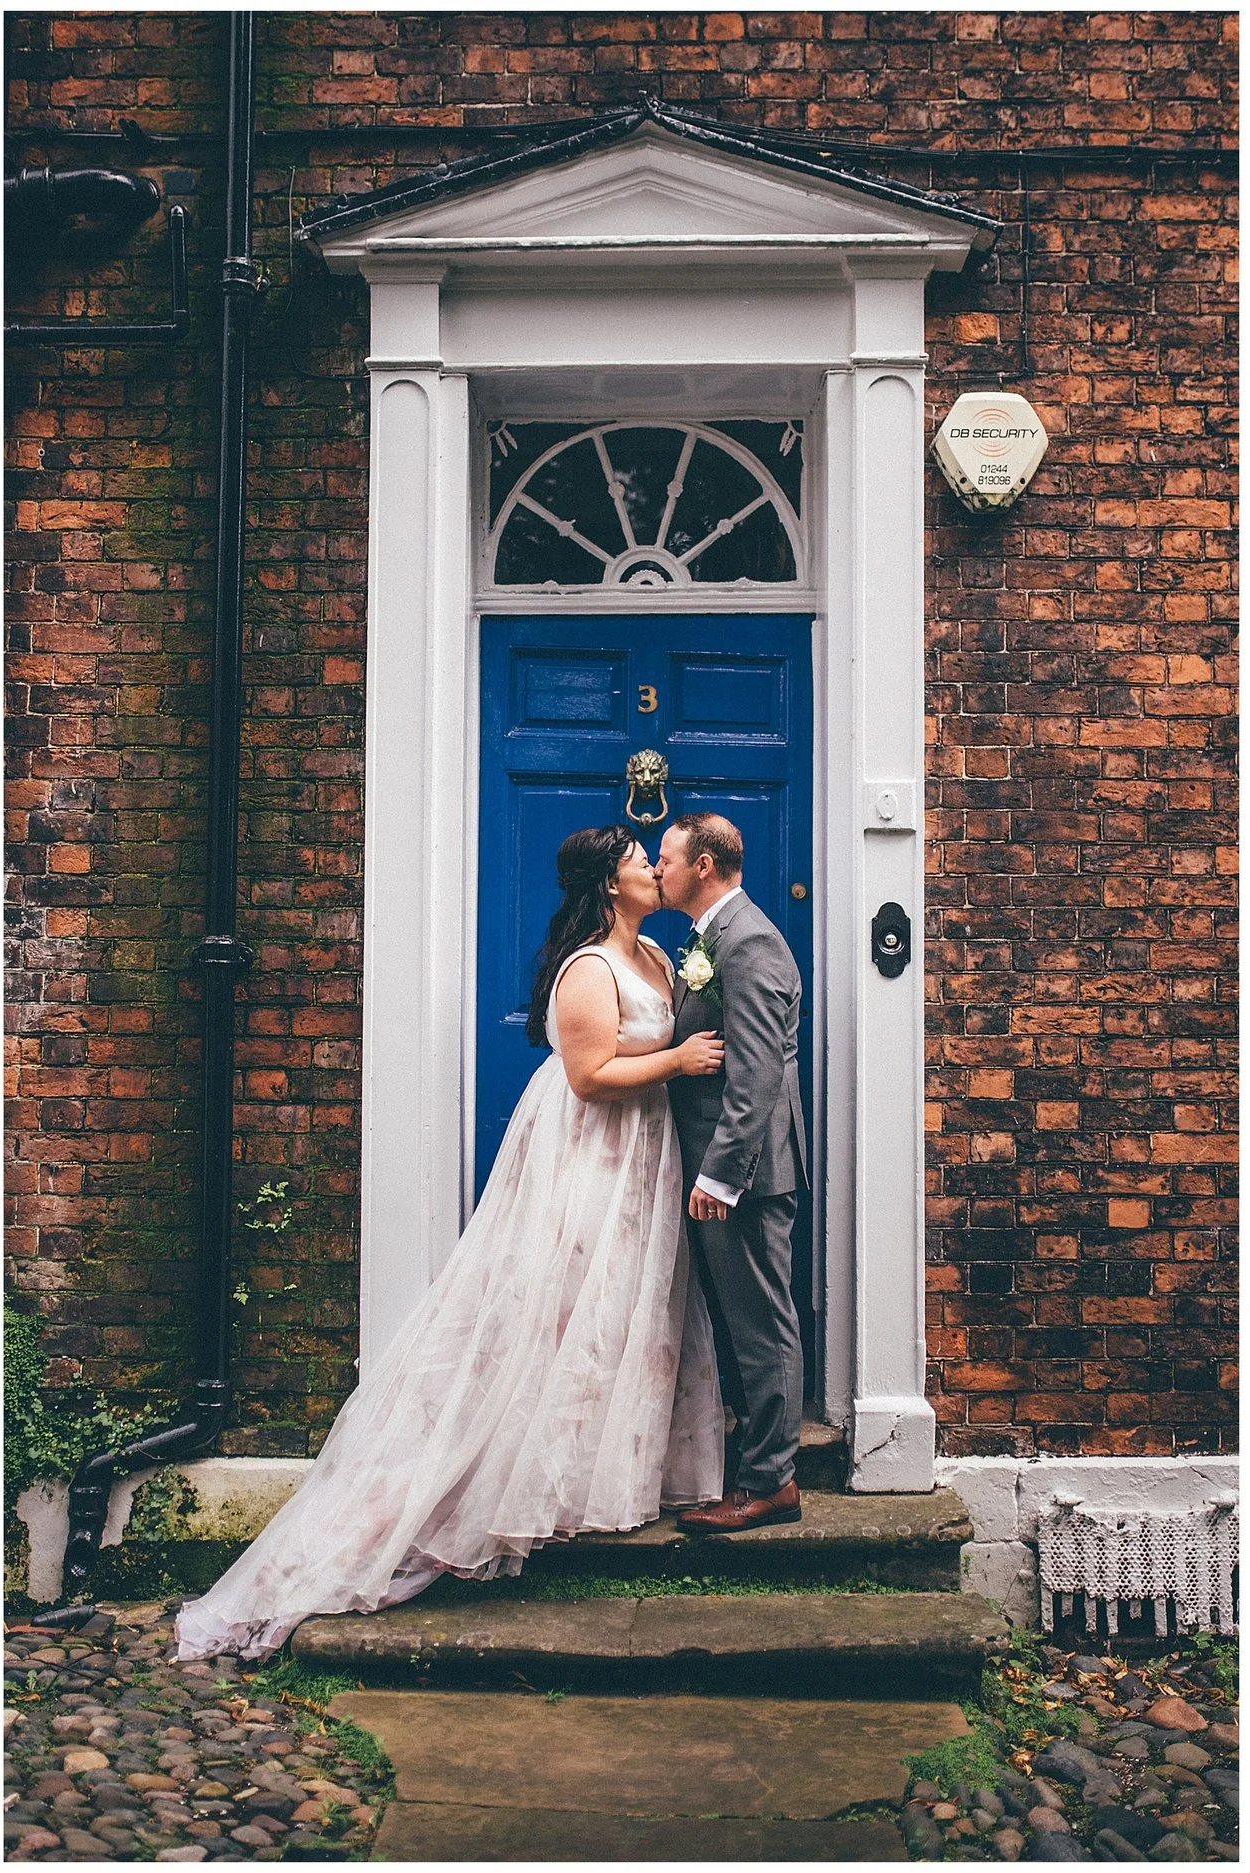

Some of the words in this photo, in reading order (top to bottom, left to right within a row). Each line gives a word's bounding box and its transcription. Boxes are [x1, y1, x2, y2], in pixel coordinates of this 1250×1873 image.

[950, 428, 970, 438] DB
[972, 428, 1039, 439] SECURITY
[980, 464, 1008, 473] 01244
[978, 475, 1011, 485] 819096
[638, 685, 658, 713] 3
